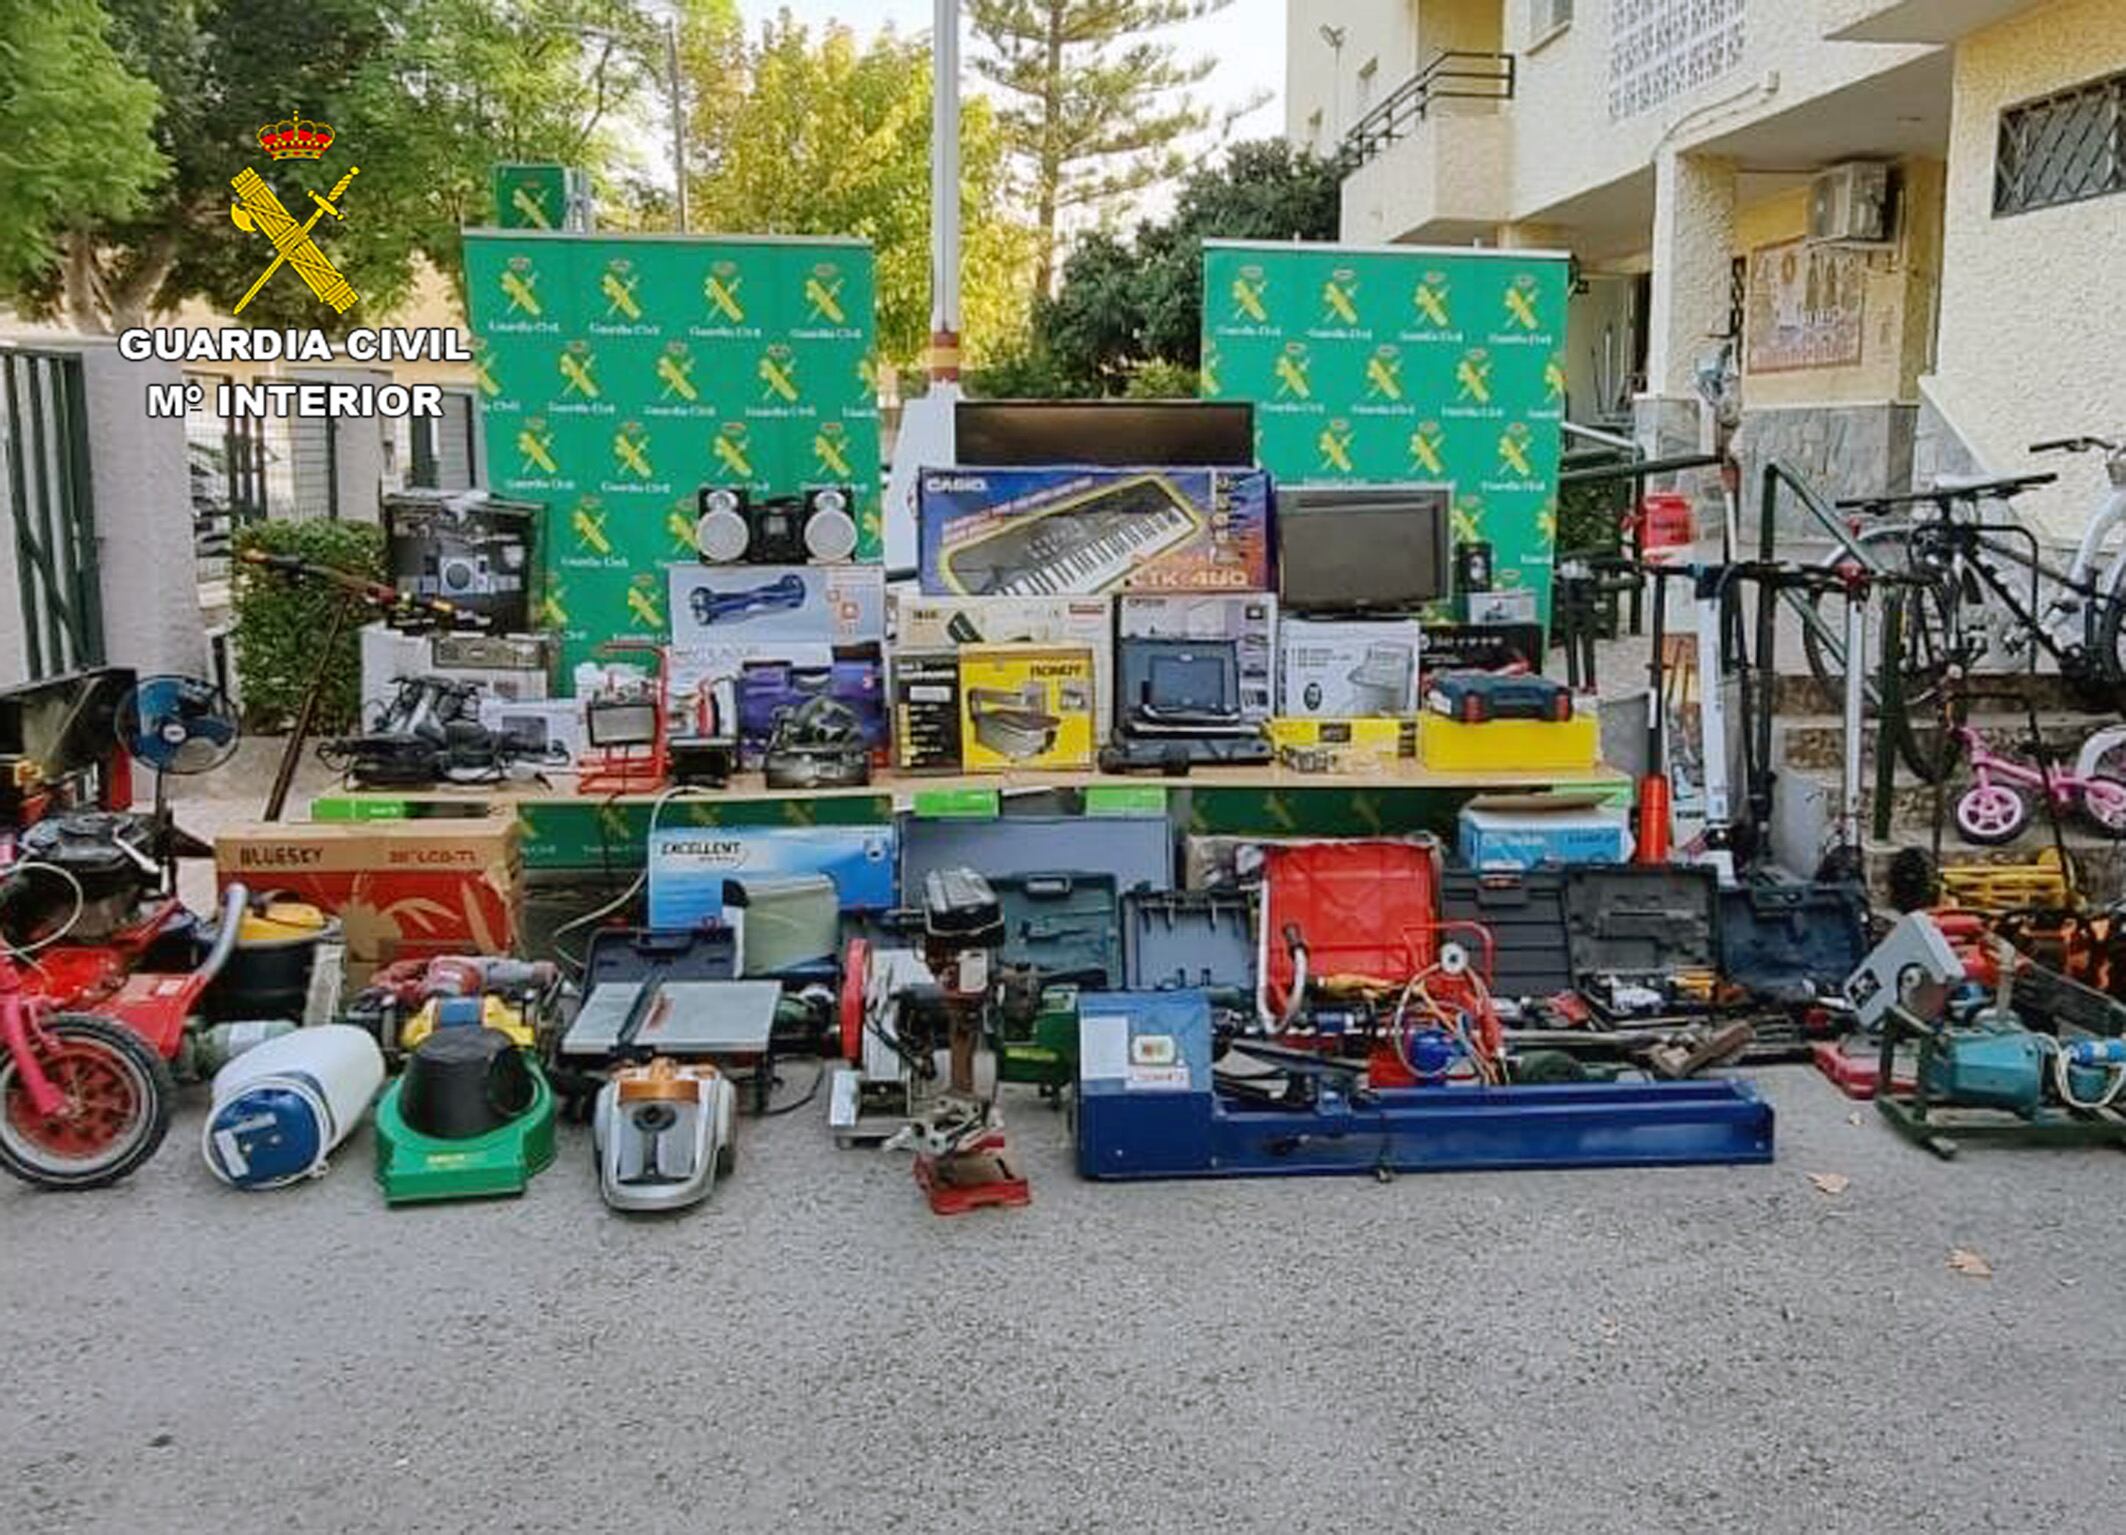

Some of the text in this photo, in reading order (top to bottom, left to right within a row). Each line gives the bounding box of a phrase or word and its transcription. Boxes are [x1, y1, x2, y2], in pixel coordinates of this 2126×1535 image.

[926, 477, 987, 493] CASIO
[662, 841, 741, 855] EXCELLENT
[240, 847, 324, 867] BLUESKY
